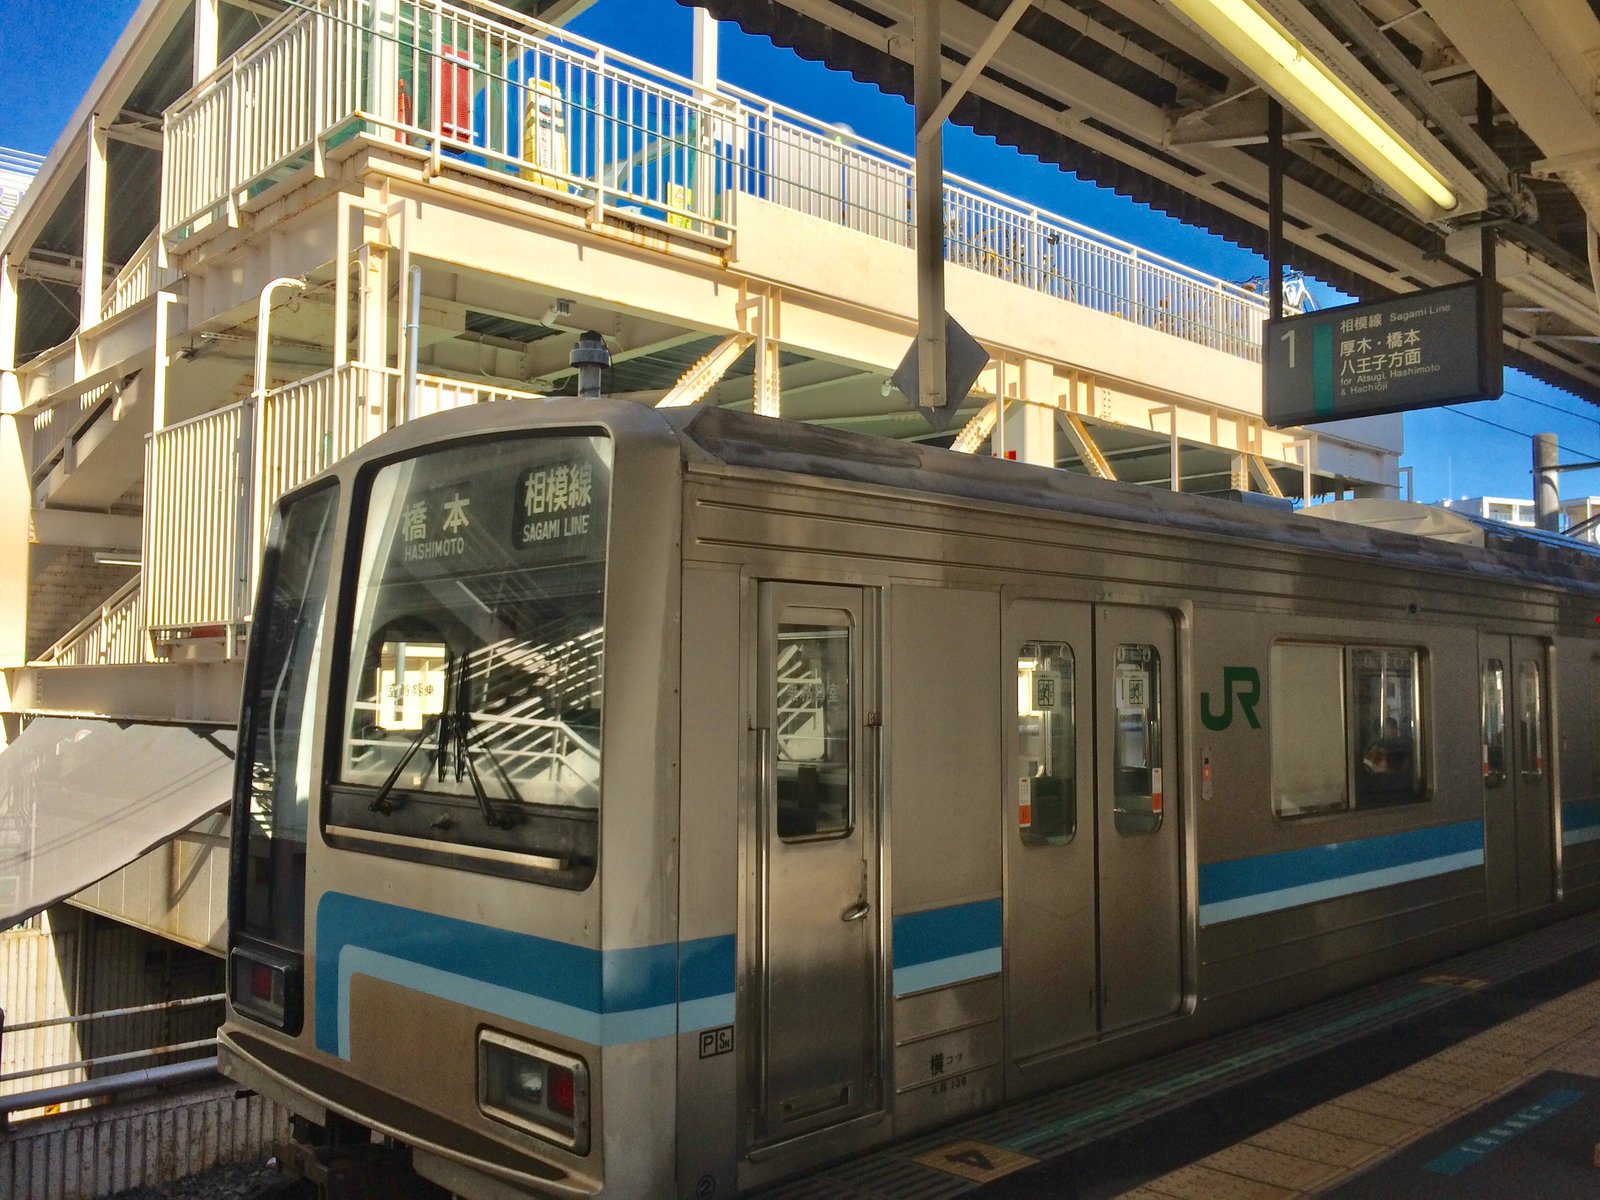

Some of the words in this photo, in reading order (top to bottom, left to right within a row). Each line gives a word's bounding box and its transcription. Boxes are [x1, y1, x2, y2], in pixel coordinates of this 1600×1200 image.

[1340, 313, 1382, 334] 相模線
[1389, 308, 1427, 323] Sagami
[1429, 304, 1451, 315] Line
[1280, 329, 1296, 369] 1
[1339, 328, 1421, 358] 厚木・橋本
[1340, 347, 1421, 376] 八王子方面
[1340, 376, 1352, 386] for
[1389, 363, 1441, 378] Hashimoto
[1340, 388, 1347, 396] &
[525, 463, 592, 517] 相模線
[402, 493, 470, 542] 橋本
[522, 520, 560, 543] SAGAMI
[564, 515, 590, 537] LINE
[404, 536, 465, 562] HASHIMOTO
[1200, 666, 1261, 731] JR
[703, 1034, 714, 1053] P
